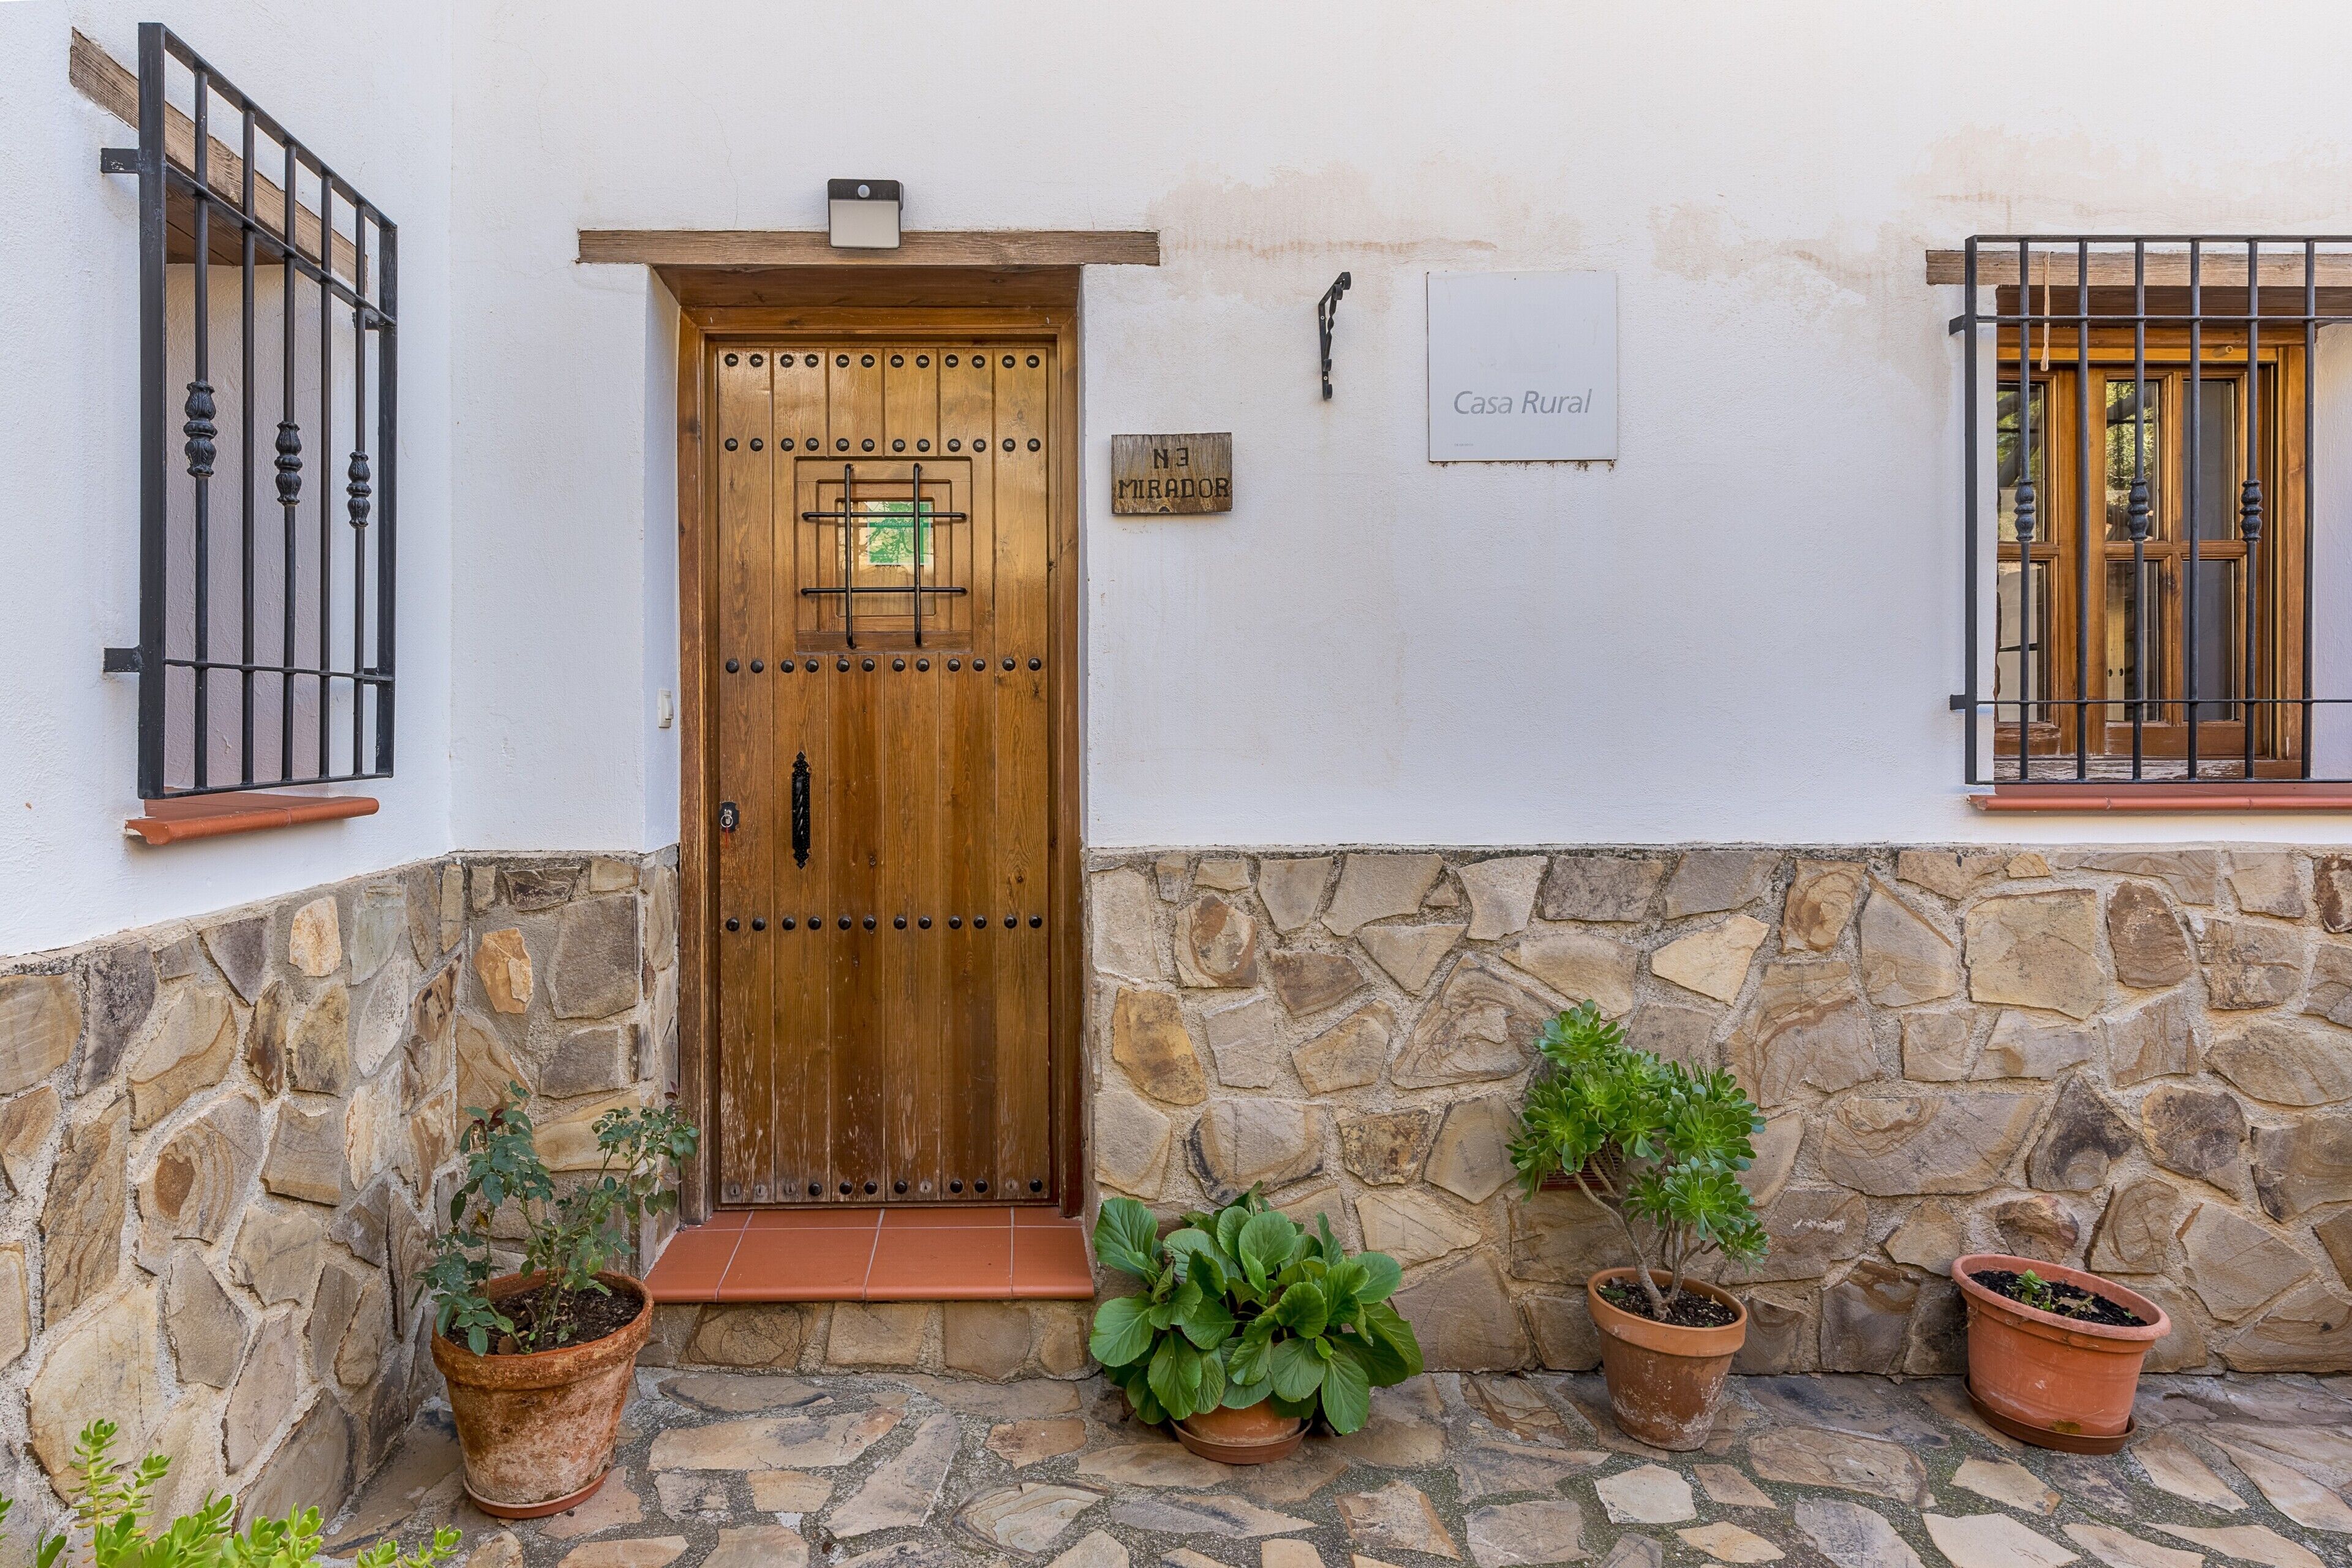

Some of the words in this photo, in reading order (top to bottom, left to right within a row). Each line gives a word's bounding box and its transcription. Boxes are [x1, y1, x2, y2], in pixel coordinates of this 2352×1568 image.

[1453, 390, 1513, 415] Casa
[1521, 388, 1593, 414] Rural
[1118, 477, 1230, 499] MIRADOR
